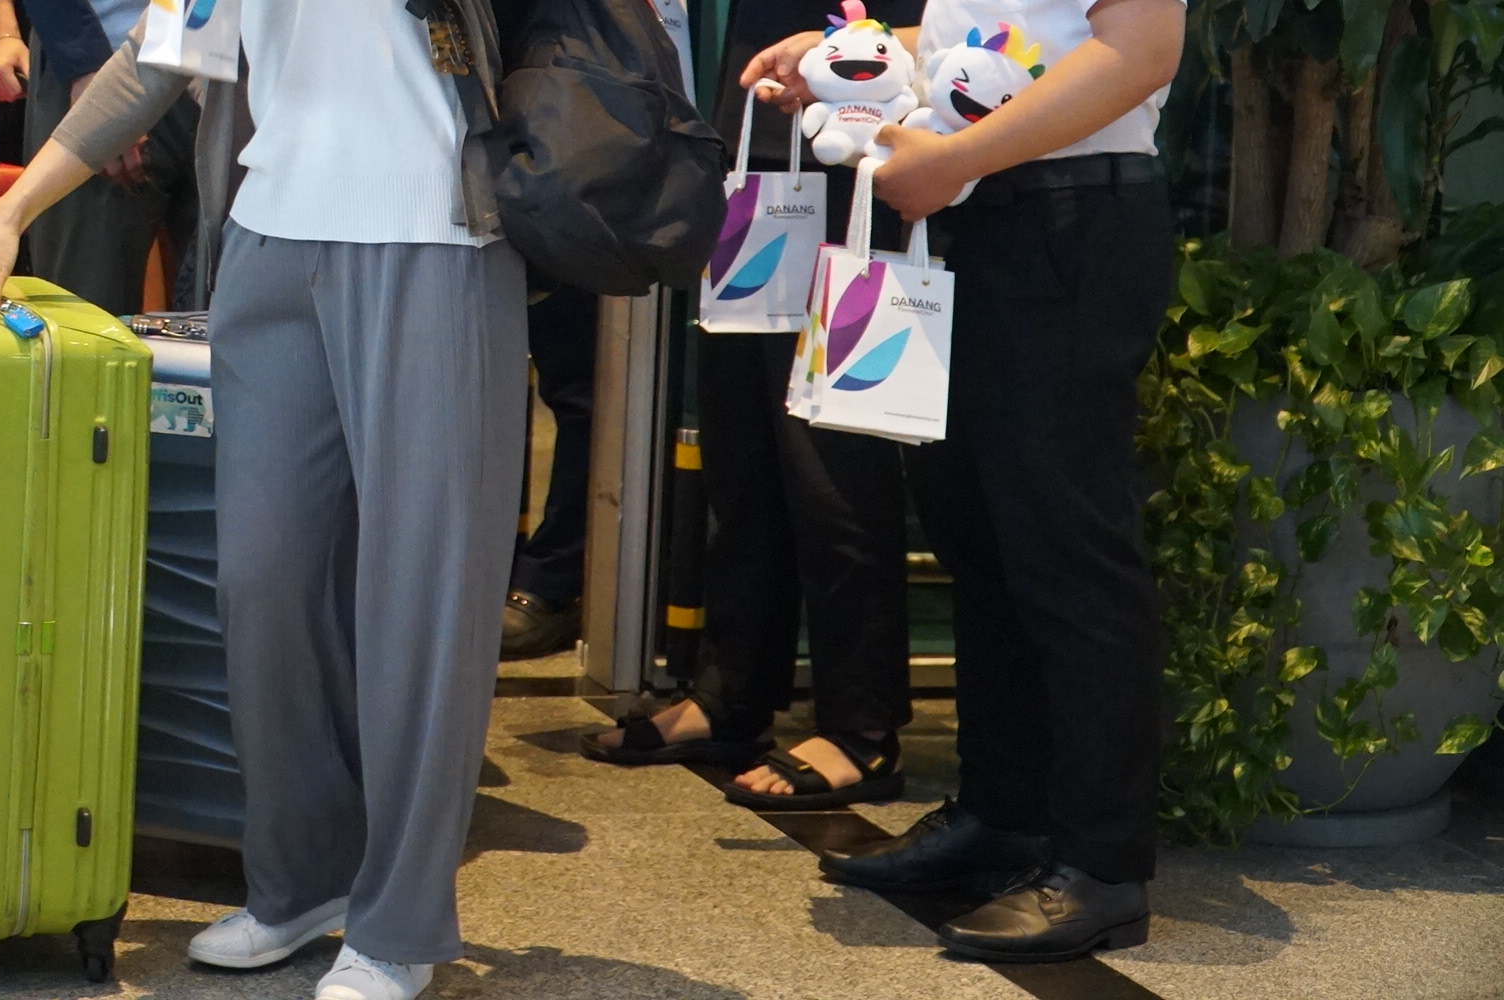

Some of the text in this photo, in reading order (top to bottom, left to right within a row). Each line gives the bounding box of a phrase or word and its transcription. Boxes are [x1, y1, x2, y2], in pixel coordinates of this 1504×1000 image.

[838, 105, 882, 118] DANANG
[766, 204, 815, 215] DANANG
[890, 296, 942, 312] DANANG
